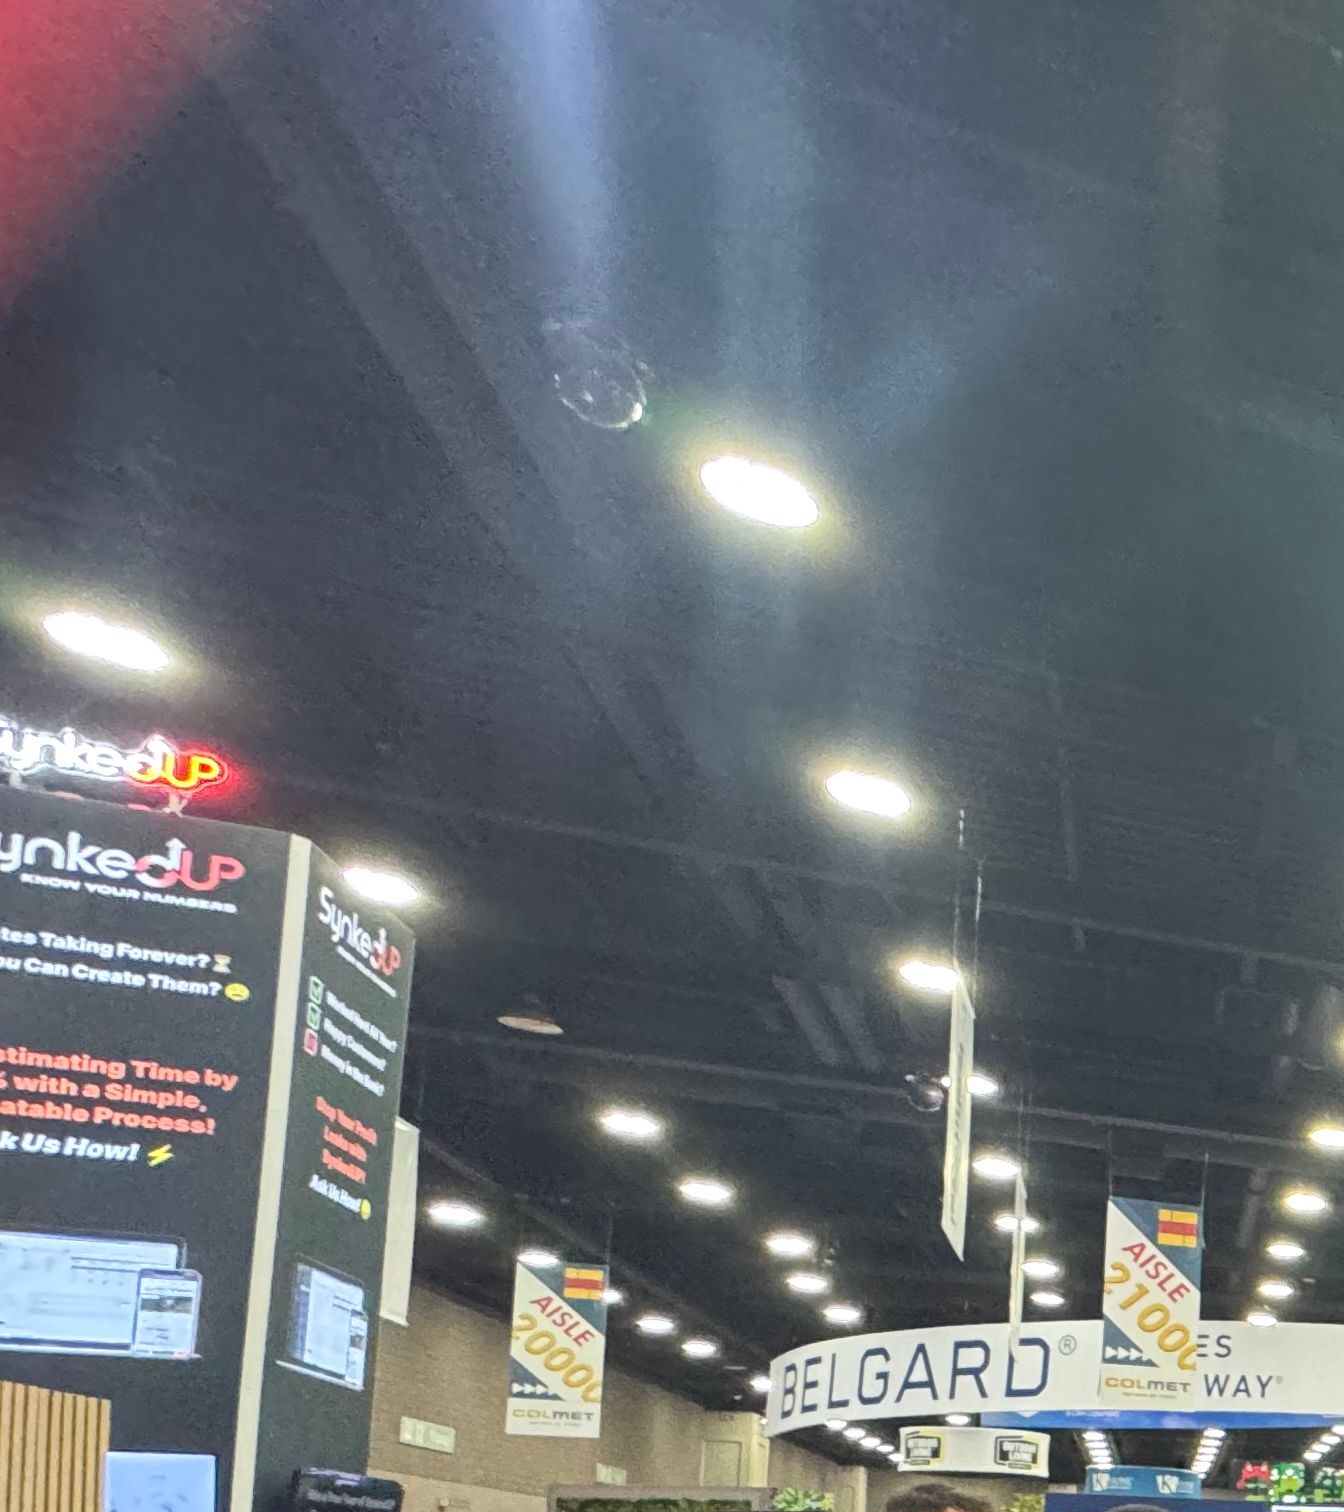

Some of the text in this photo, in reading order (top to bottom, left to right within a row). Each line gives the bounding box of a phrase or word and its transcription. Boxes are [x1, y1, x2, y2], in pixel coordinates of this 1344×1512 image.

[0, 727, 221, 788] ynkedUP
[0, 831, 245, 891] ynkedUP
[39, 932, 114, 960] Taking
[117, 943, 211, 968] Forever?
[23, 957, 69, 978] Can
[71, 963, 146, 987] Create
[147, 974, 222, 997] Them?
[13, 1075, 78, 1097] with
[83, 1084, 100, 1099] a
[130, 1060, 200, 1084] Time
[203, 1069, 238, 1092] by
[0, 1100, 216, 1136] atable Process!
[21, 1133, 59, 1155] Us
[63, 1137, 141, 1162] How!
[1122, 1242, 1190, 1303] AISLE
[528, 1296, 595, 1346] AISLE
[1105, 1377, 1191, 1393] COLMET
[512, 1409, 595, 1422] COLMET
